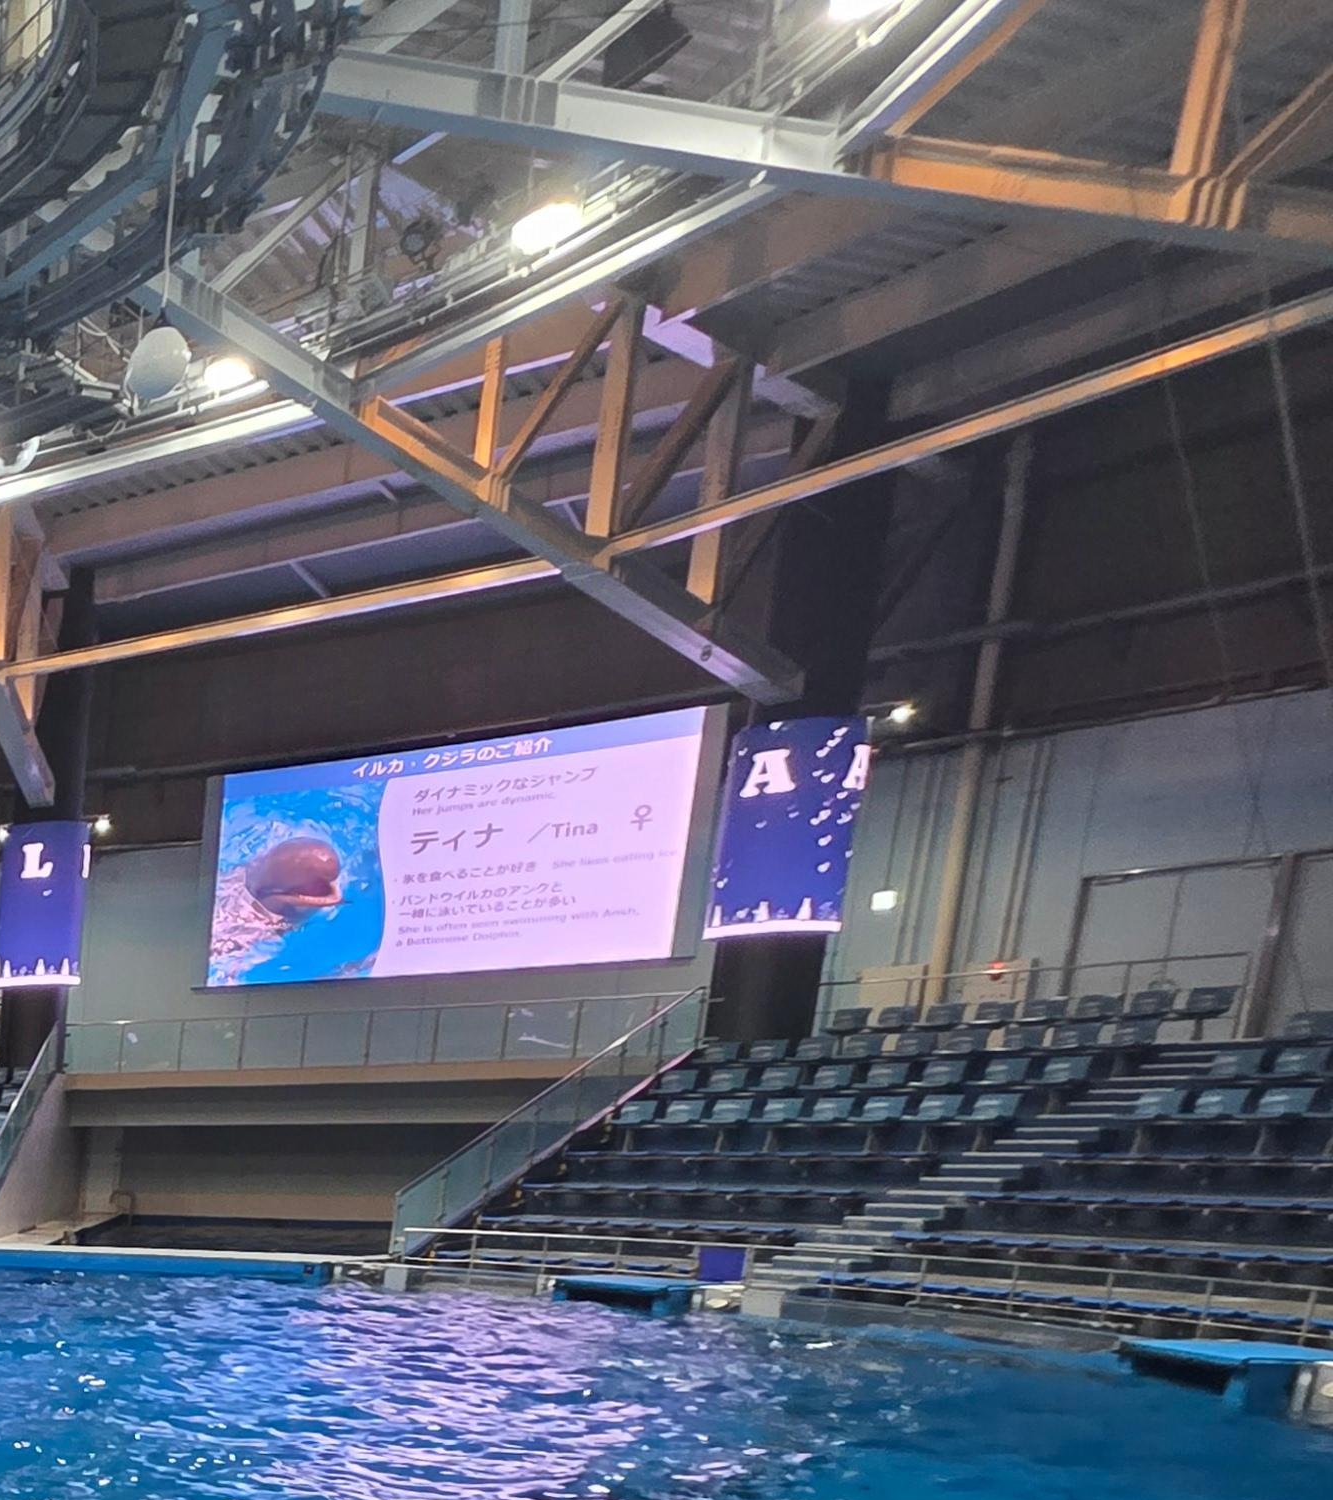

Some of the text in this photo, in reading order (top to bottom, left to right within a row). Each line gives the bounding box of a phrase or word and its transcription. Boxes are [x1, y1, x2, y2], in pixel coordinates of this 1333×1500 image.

[352, 736, 553, 778] イルカ・クジラのご紹介
[738, 748, 797, 799] A
[413, 765, 599, 803] ダイナミックなジャンプ
[412, 805, 434, 817] Her
[436, 801, 474, 816] jumps
[478, 798, 498, 809] are
[410, 822, 504, 855] ティナ
[20, 842, 54, 879] L
[398, 924, 421, 936] She
[436, 921, 468, 933] often
